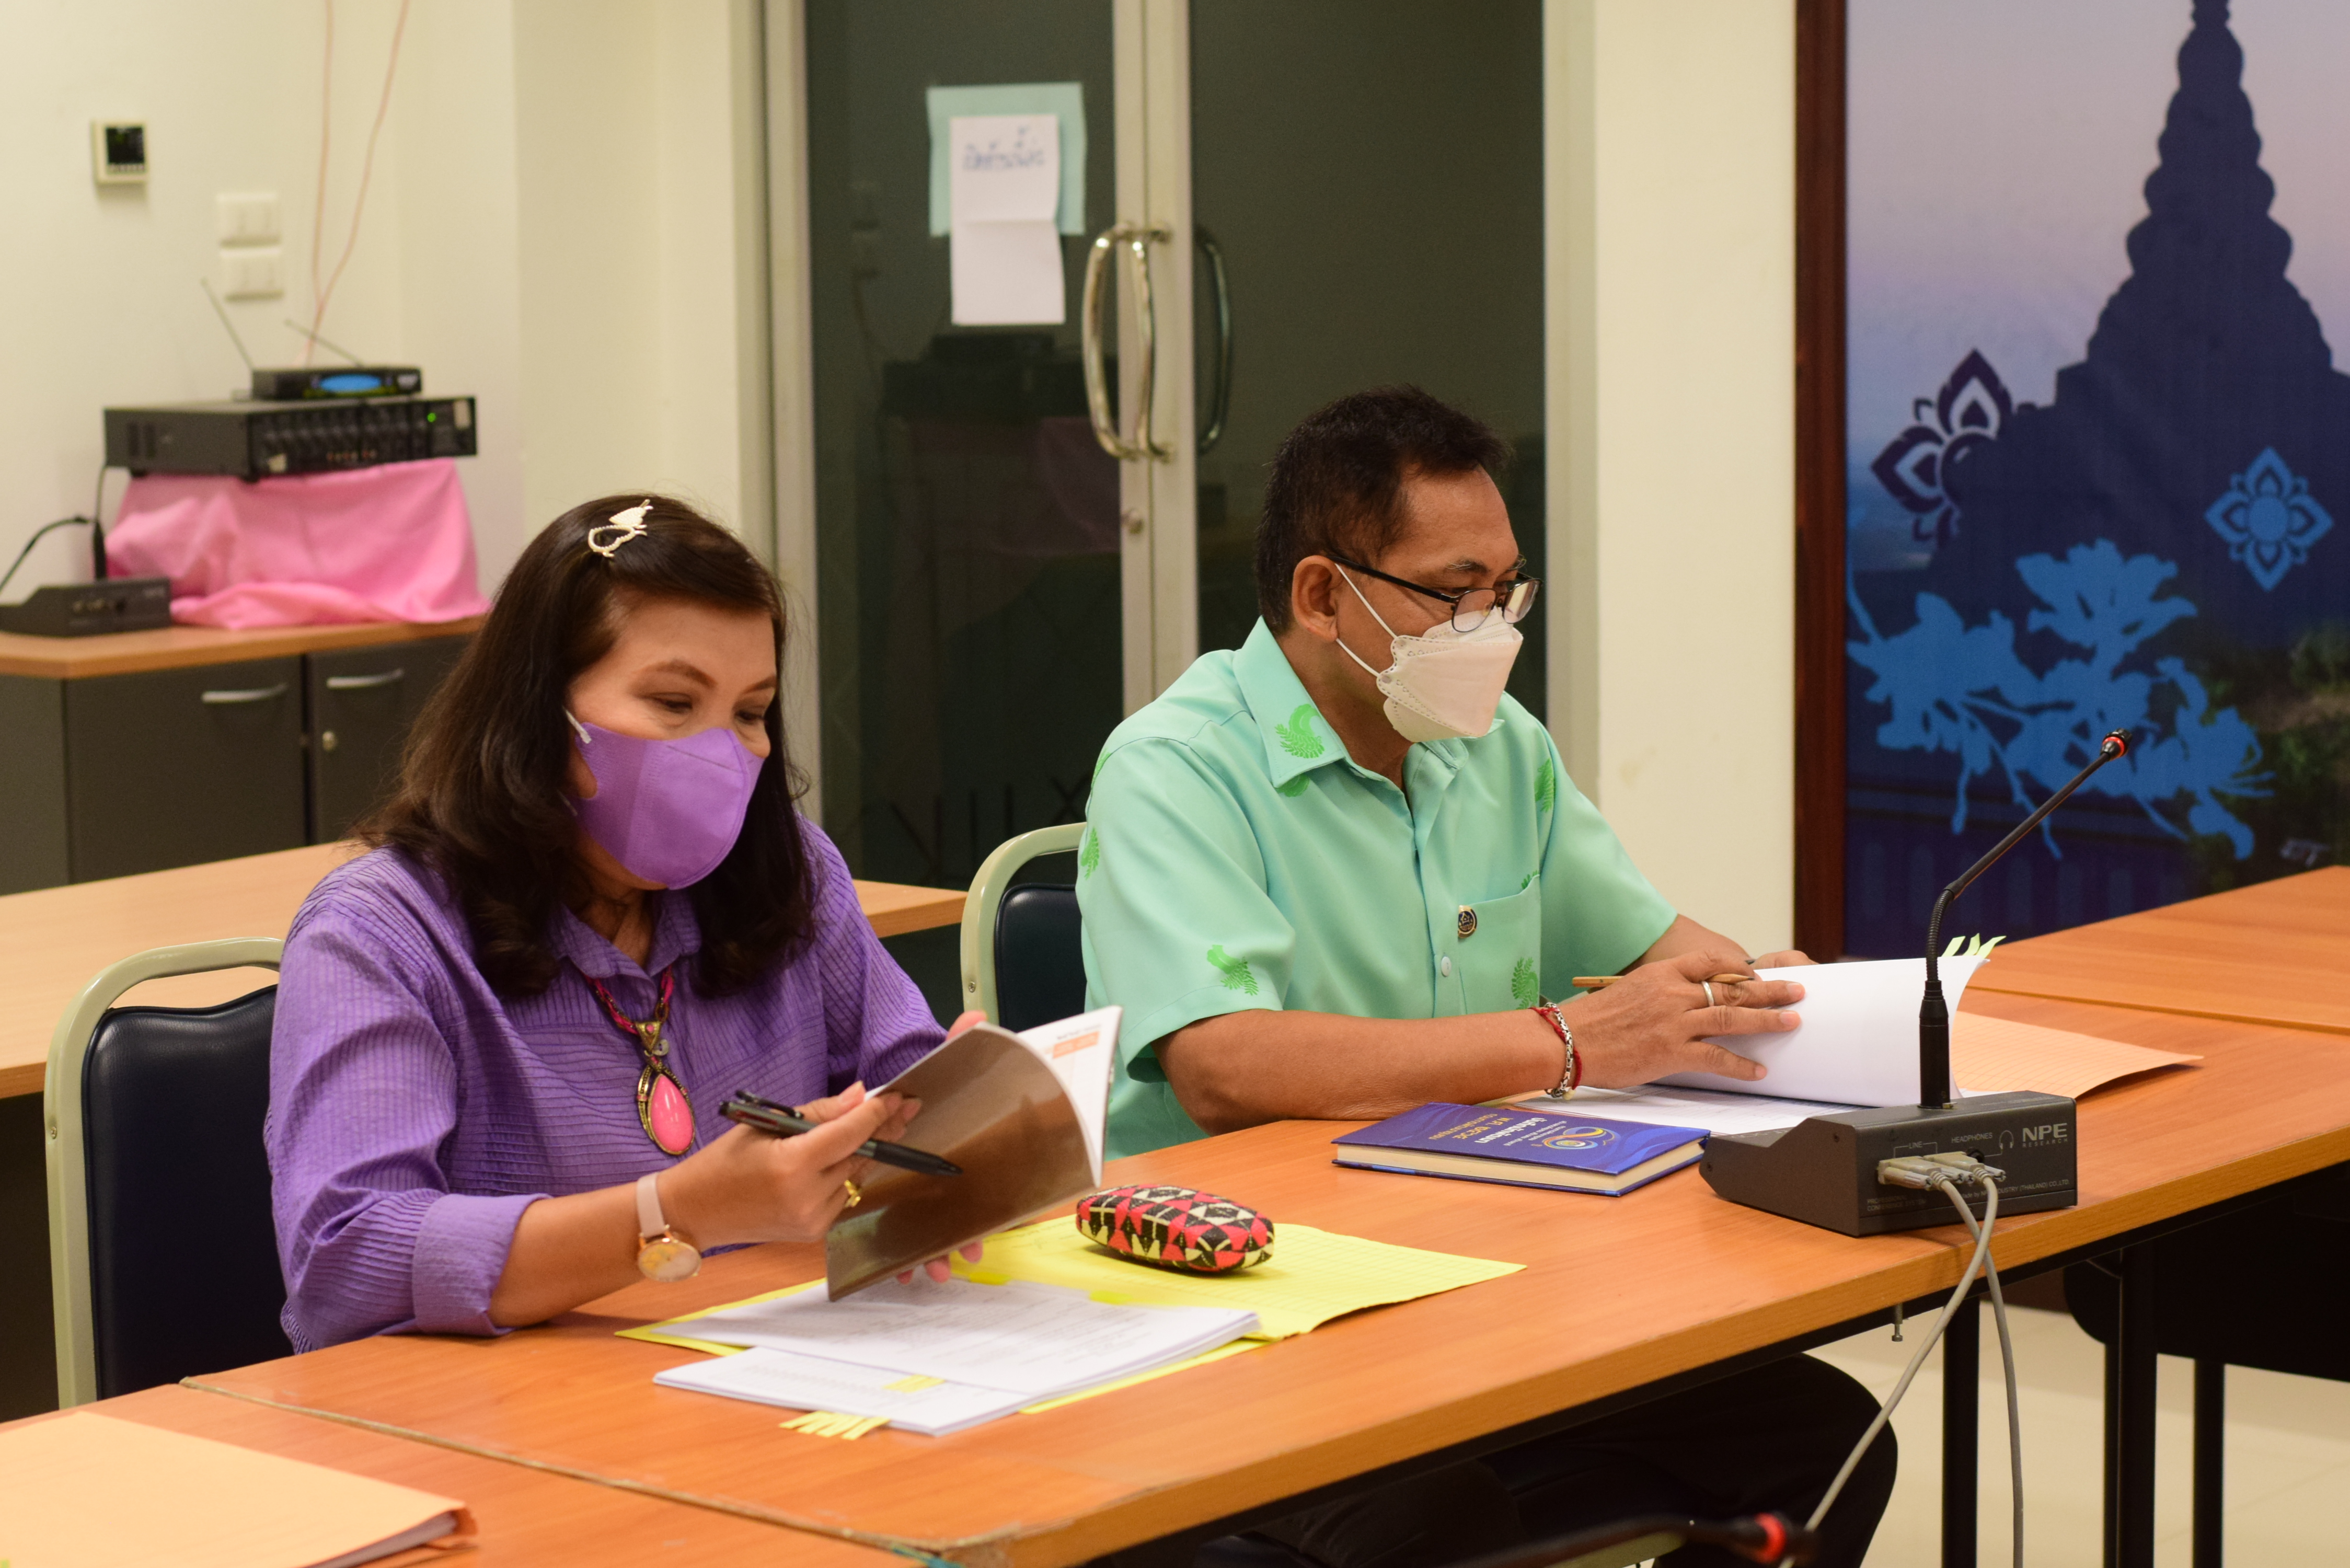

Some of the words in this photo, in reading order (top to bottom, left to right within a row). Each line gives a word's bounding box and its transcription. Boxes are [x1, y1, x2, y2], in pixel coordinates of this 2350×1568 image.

[1474, 1117, 1548, 1144] บันทึกนักพัฒนา
[2022, 1123, 2068, 1143] NPE
[1951, 1132, 1993, 1144] HEADPHONES
[2022, 1138, 2068, 1148] RESEARCH
[1997, 1186, 2019, 1194] DUSTRY
[2020, 1182, 2048, 1192] (THAILAND)
